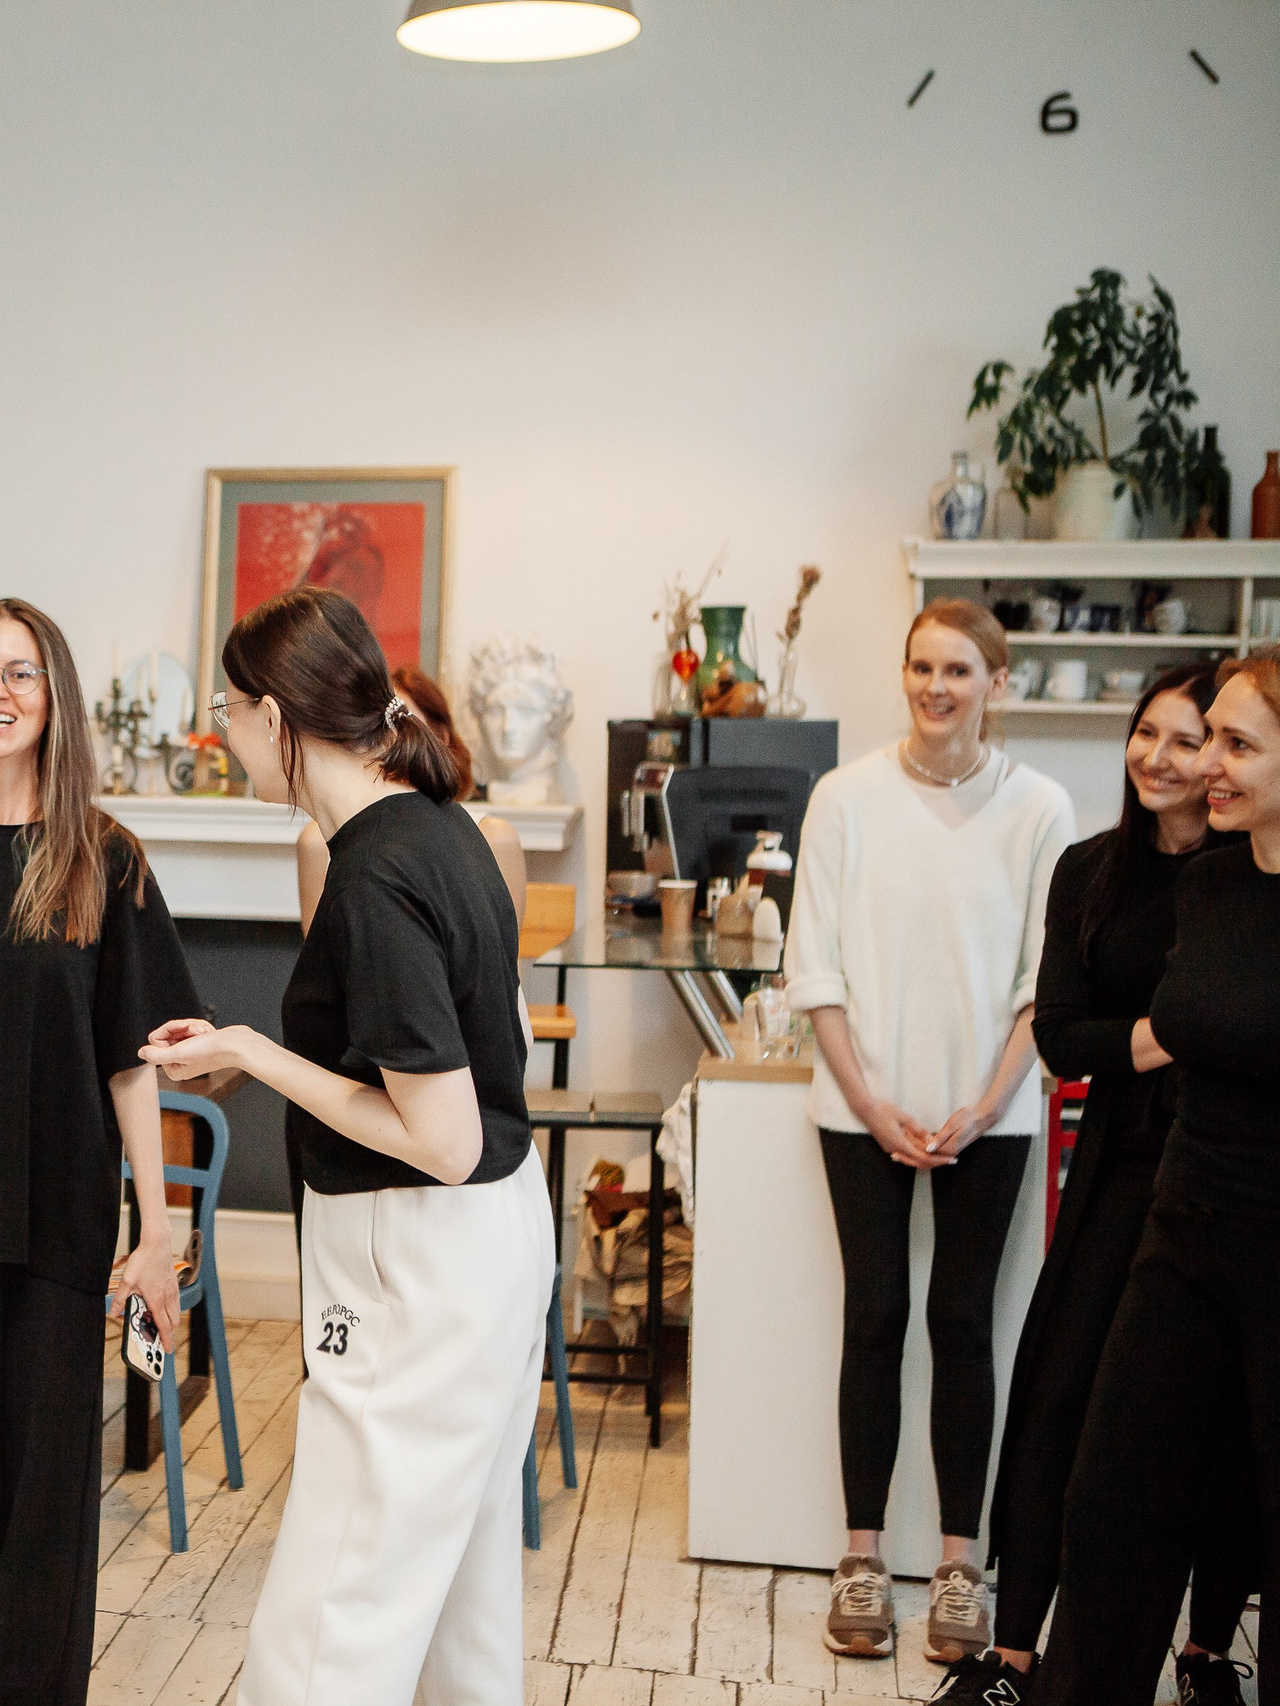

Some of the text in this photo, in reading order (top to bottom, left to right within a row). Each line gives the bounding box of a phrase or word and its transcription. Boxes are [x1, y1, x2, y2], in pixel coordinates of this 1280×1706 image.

[1040, 91, 1078, 134] 6
[316, 1321, 349, 1356] 23
[983, 1679, 1021, 1706] N
